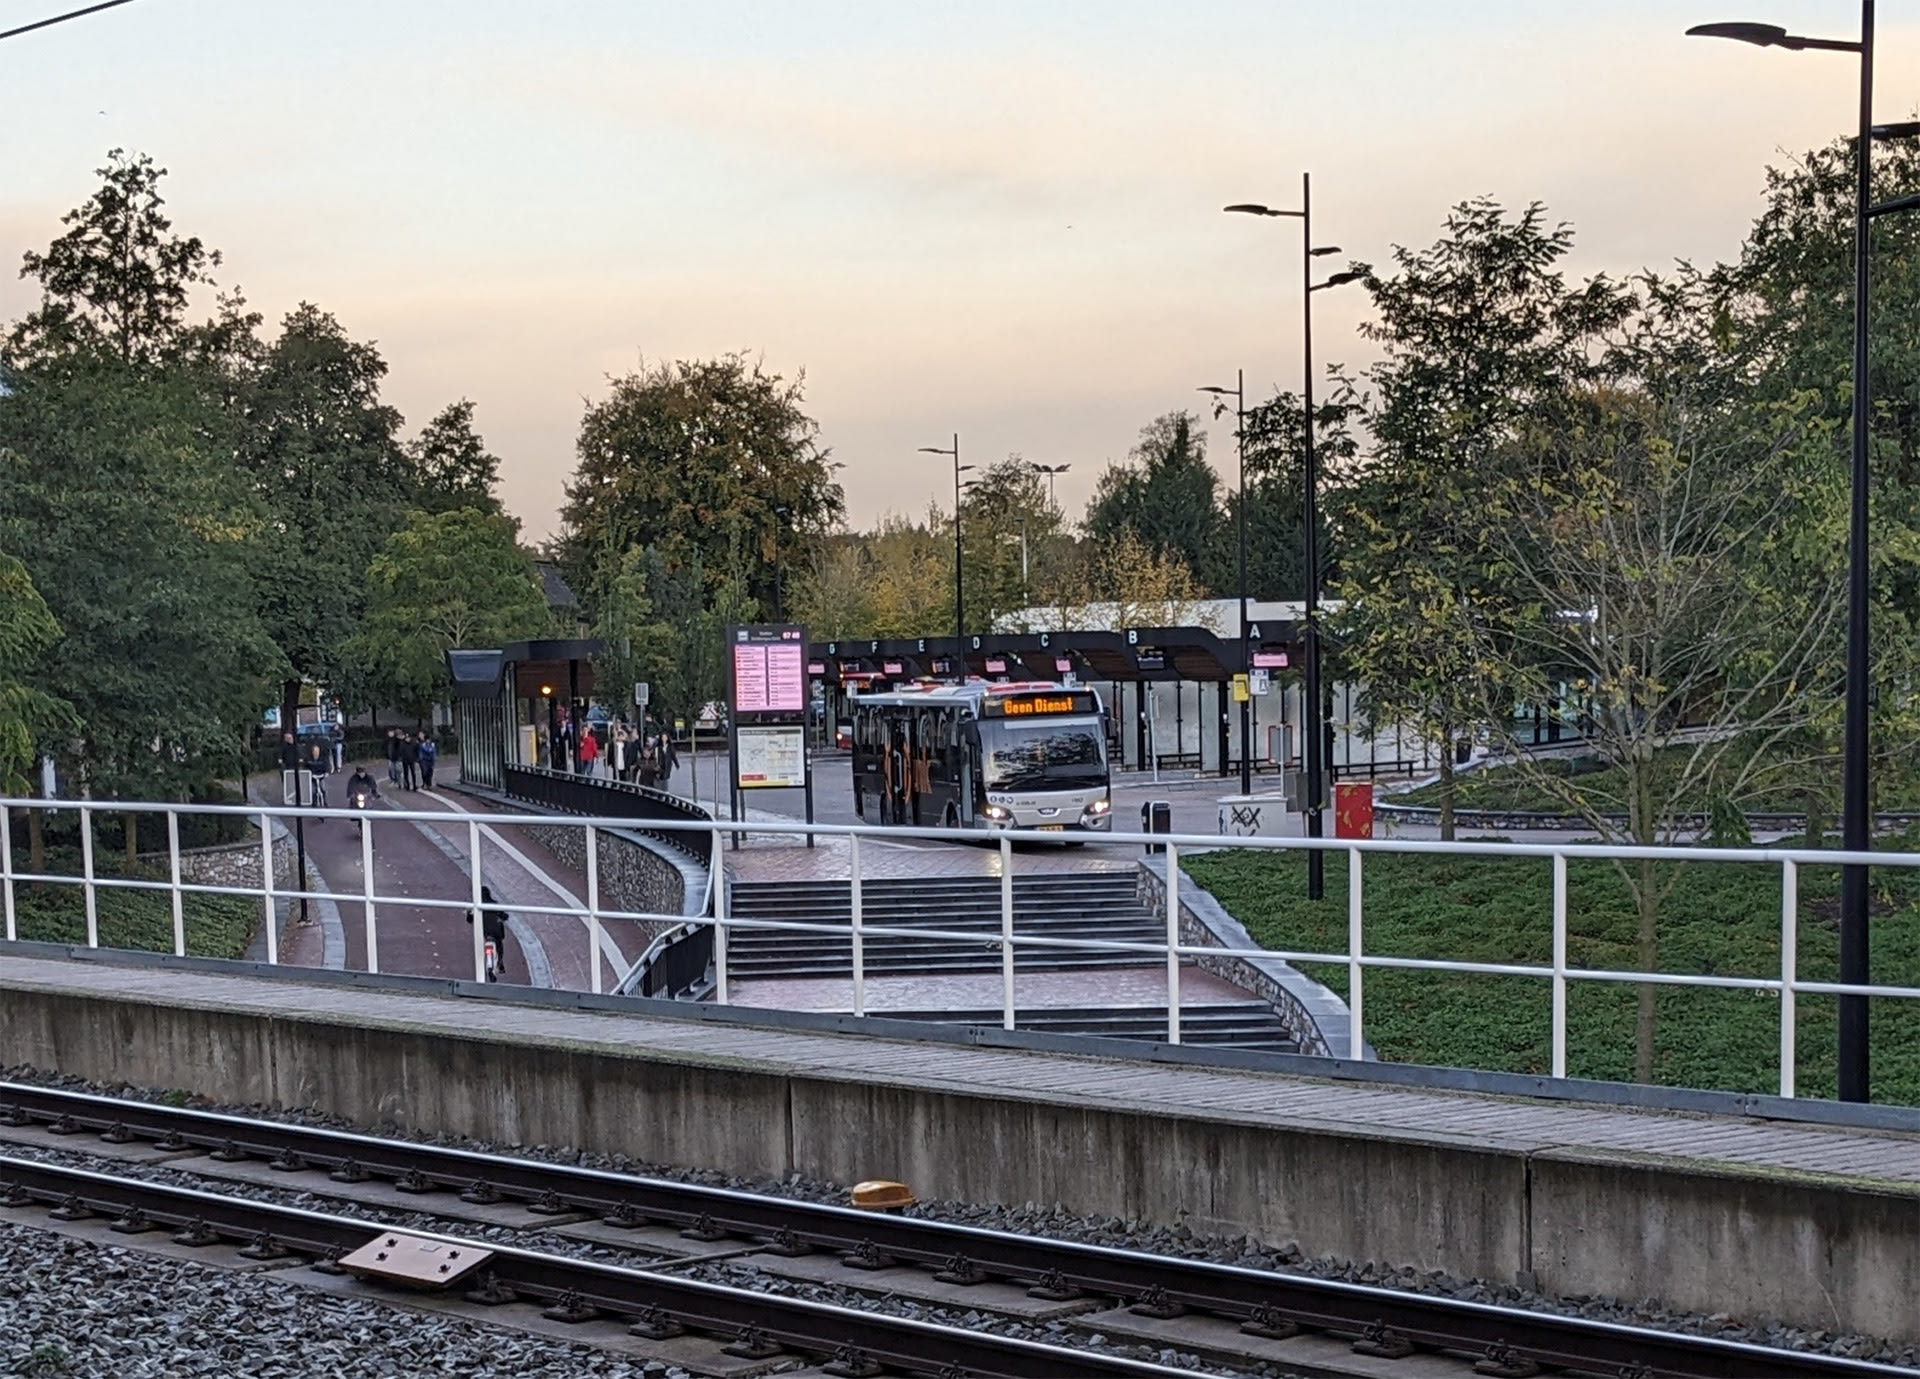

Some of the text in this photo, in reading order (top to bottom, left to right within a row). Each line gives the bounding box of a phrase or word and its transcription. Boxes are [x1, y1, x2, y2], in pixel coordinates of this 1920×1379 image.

[1128, 630, 1138, 644] B
[1249, 623, 1261, 638] A
[918, 640, 925, 652] E
[973, 636, 980, 649] D
[1041, 634, 1048, 647] C
[871, 641, 878, 654] F
[1004, 697, 1073, 714] Geen Dienst
